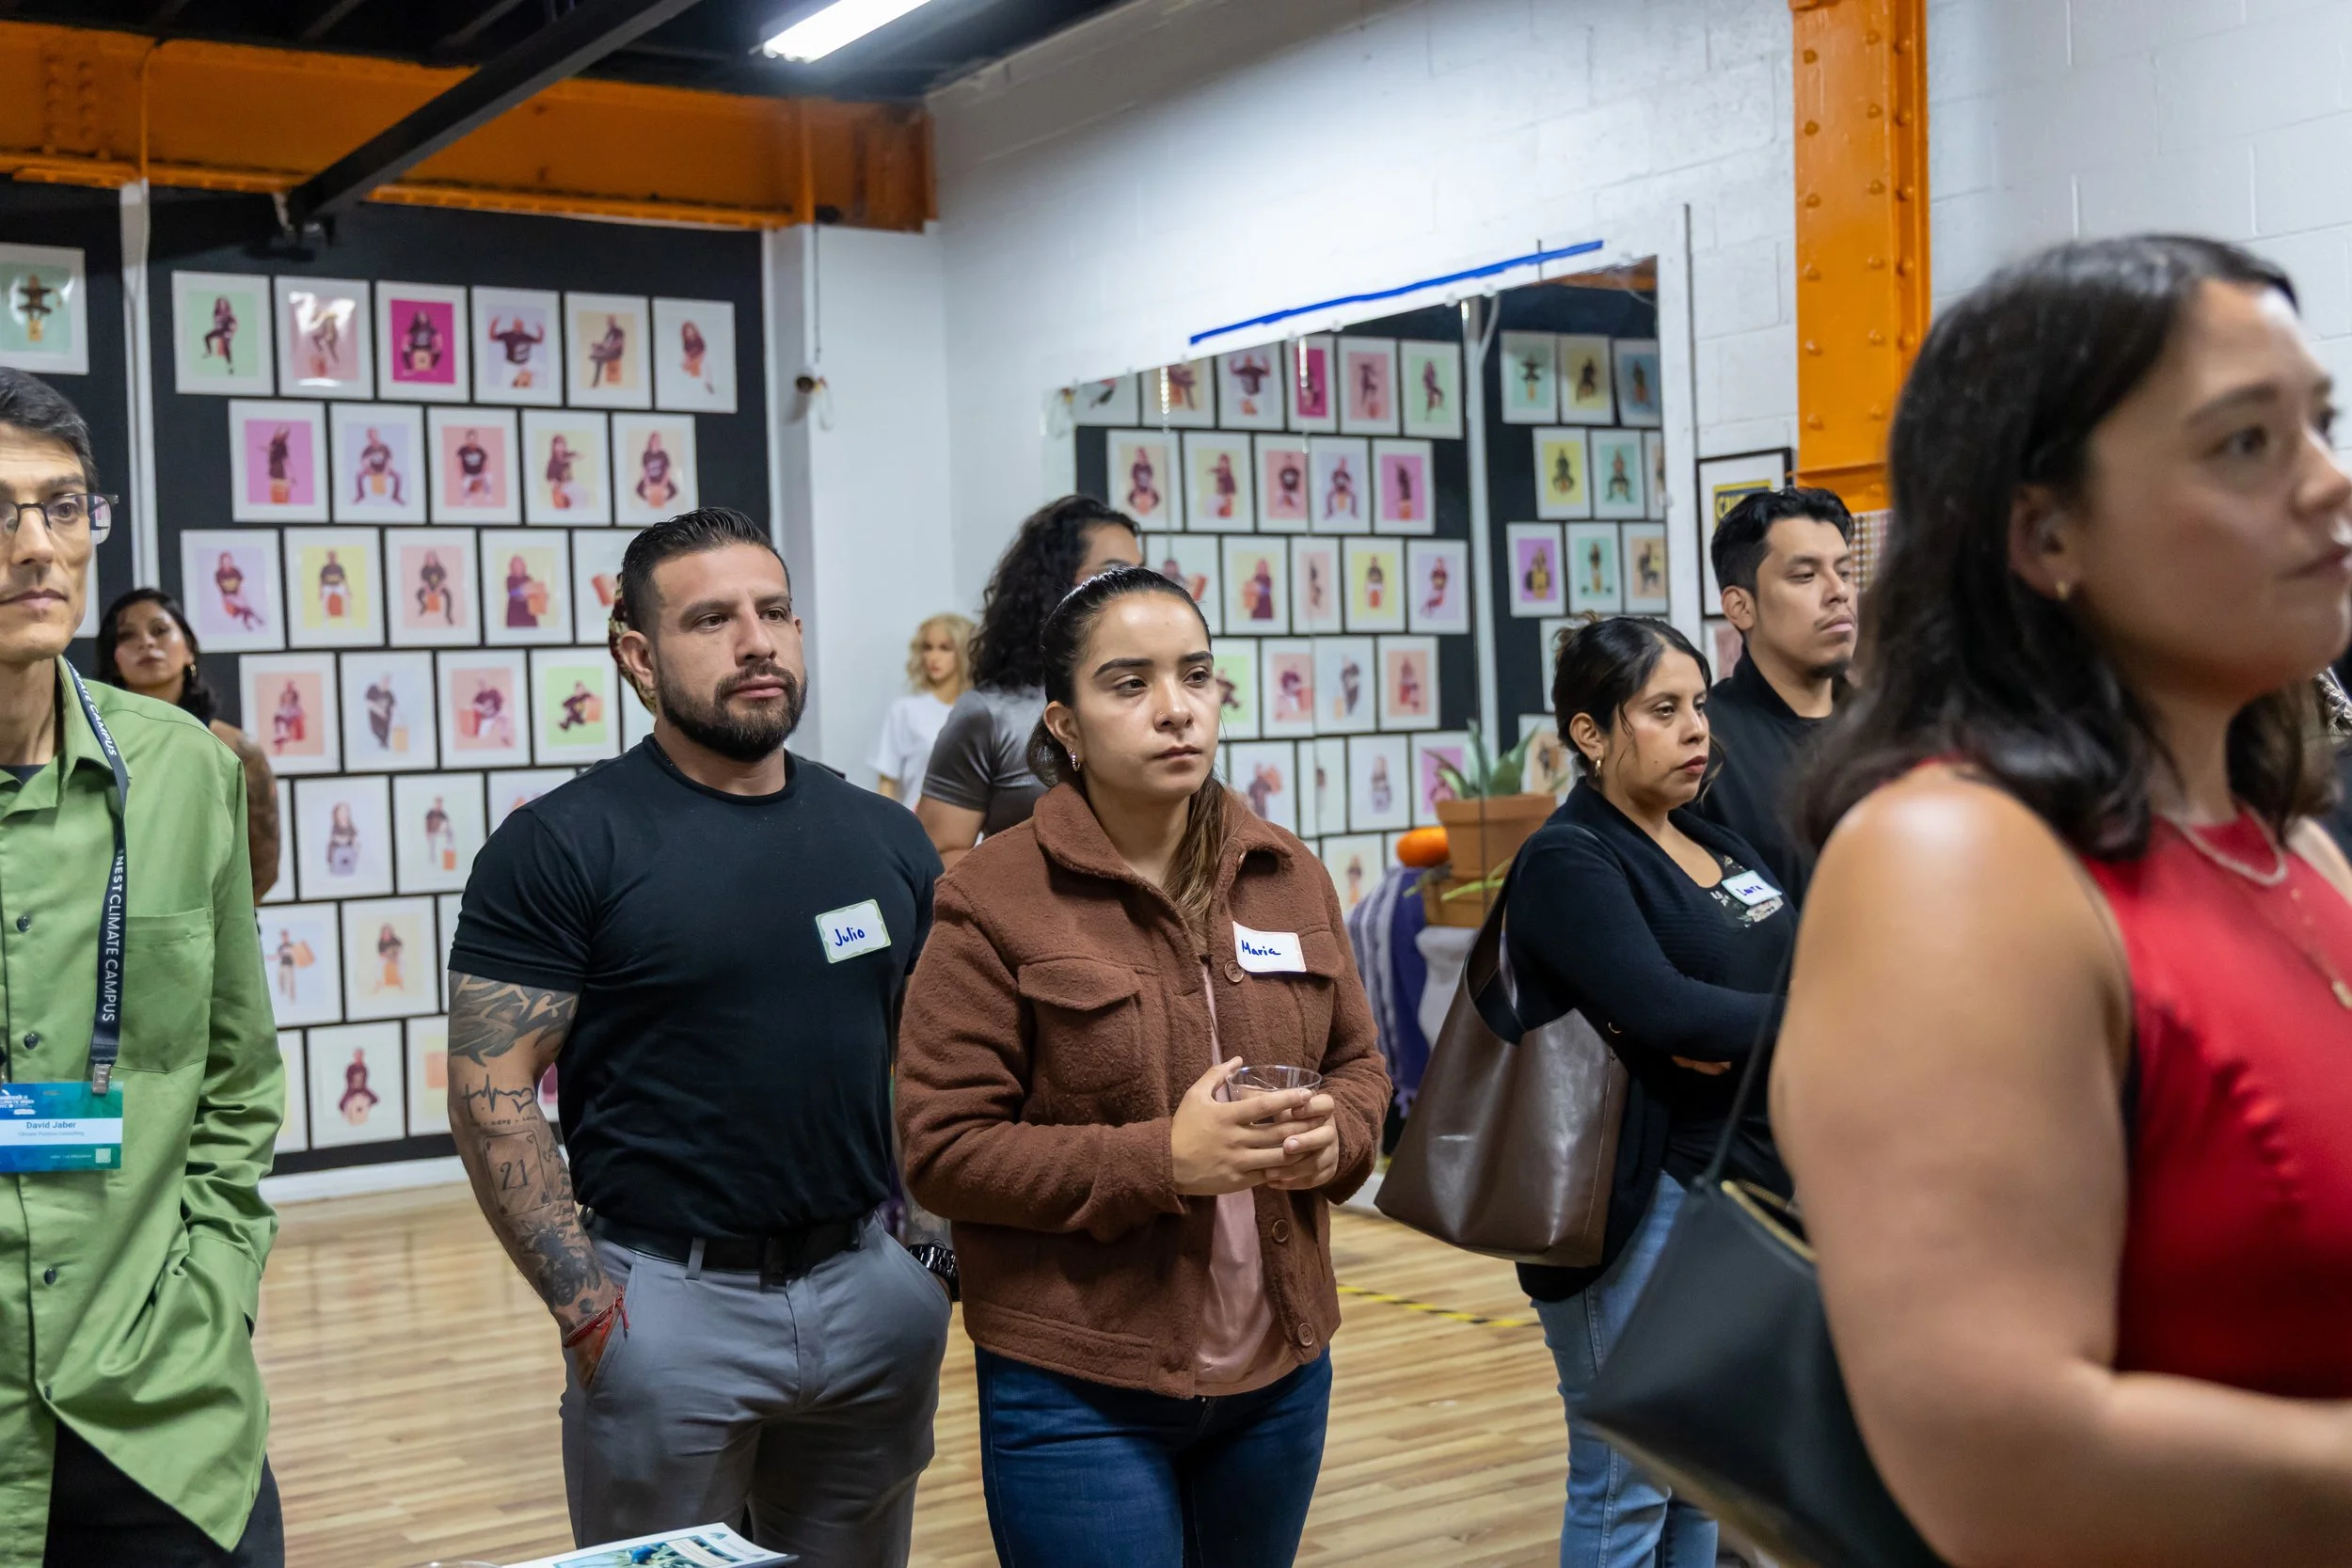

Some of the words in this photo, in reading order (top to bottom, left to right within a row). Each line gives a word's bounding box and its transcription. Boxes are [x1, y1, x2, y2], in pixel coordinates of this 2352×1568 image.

[90, 704, 117, 756] CAMPUS
[112, 856, 124, 892] NEST
[105, 895, 121, 956] CLIMATE
[834, 927, 866, 946] Julio
[1241, 939, 1281, 956] Maria
[102, 958, 119, 1022] CAMPUS
[500, 1158, 531, 1191] 21
